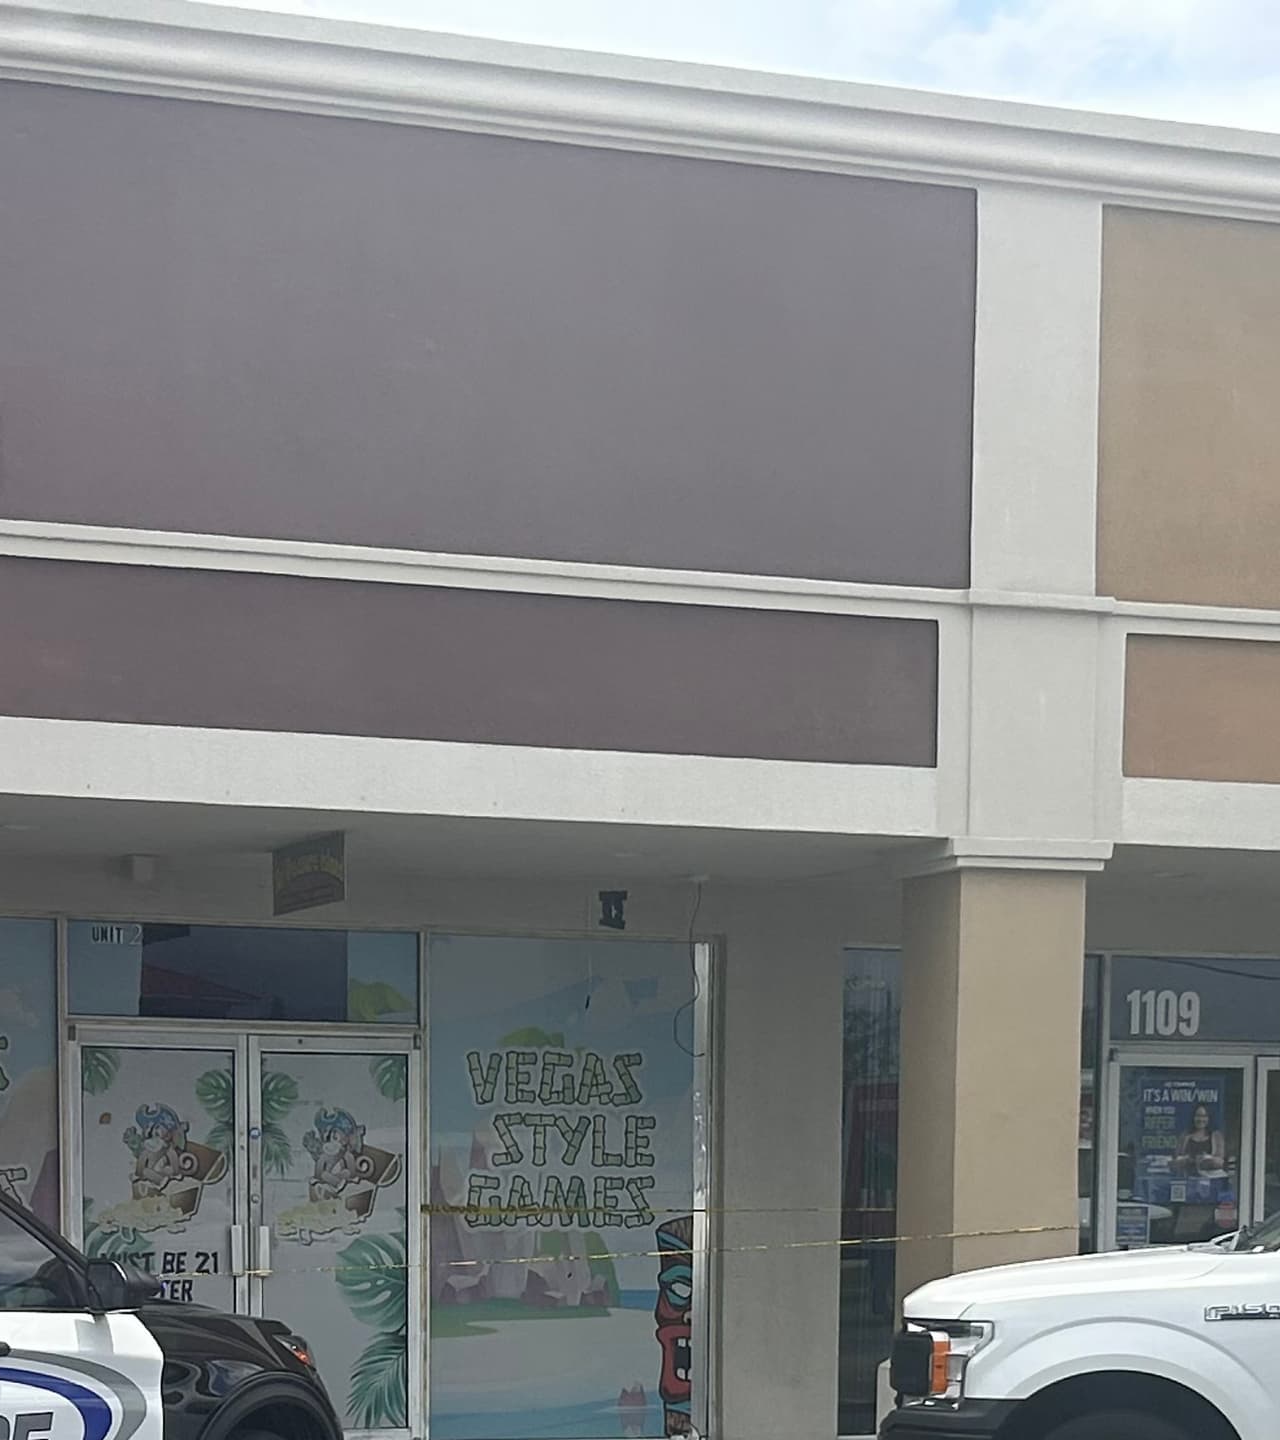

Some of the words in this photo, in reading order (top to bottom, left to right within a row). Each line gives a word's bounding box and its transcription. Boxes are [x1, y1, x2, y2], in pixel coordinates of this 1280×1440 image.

[91, 926, 124, 945] UNIT
[128, 924, 142, 945] 2
[1126, 990, 1201, 1037] 1109
[467, 1051, 642, 1106] VEGAS
[492, 1112, 656, 1168] STYLE
[465, 1174, 655, 1229] GAMES
[162, 1252, 187, 1275] BE
[195, 1252, 218, 1275] 21
